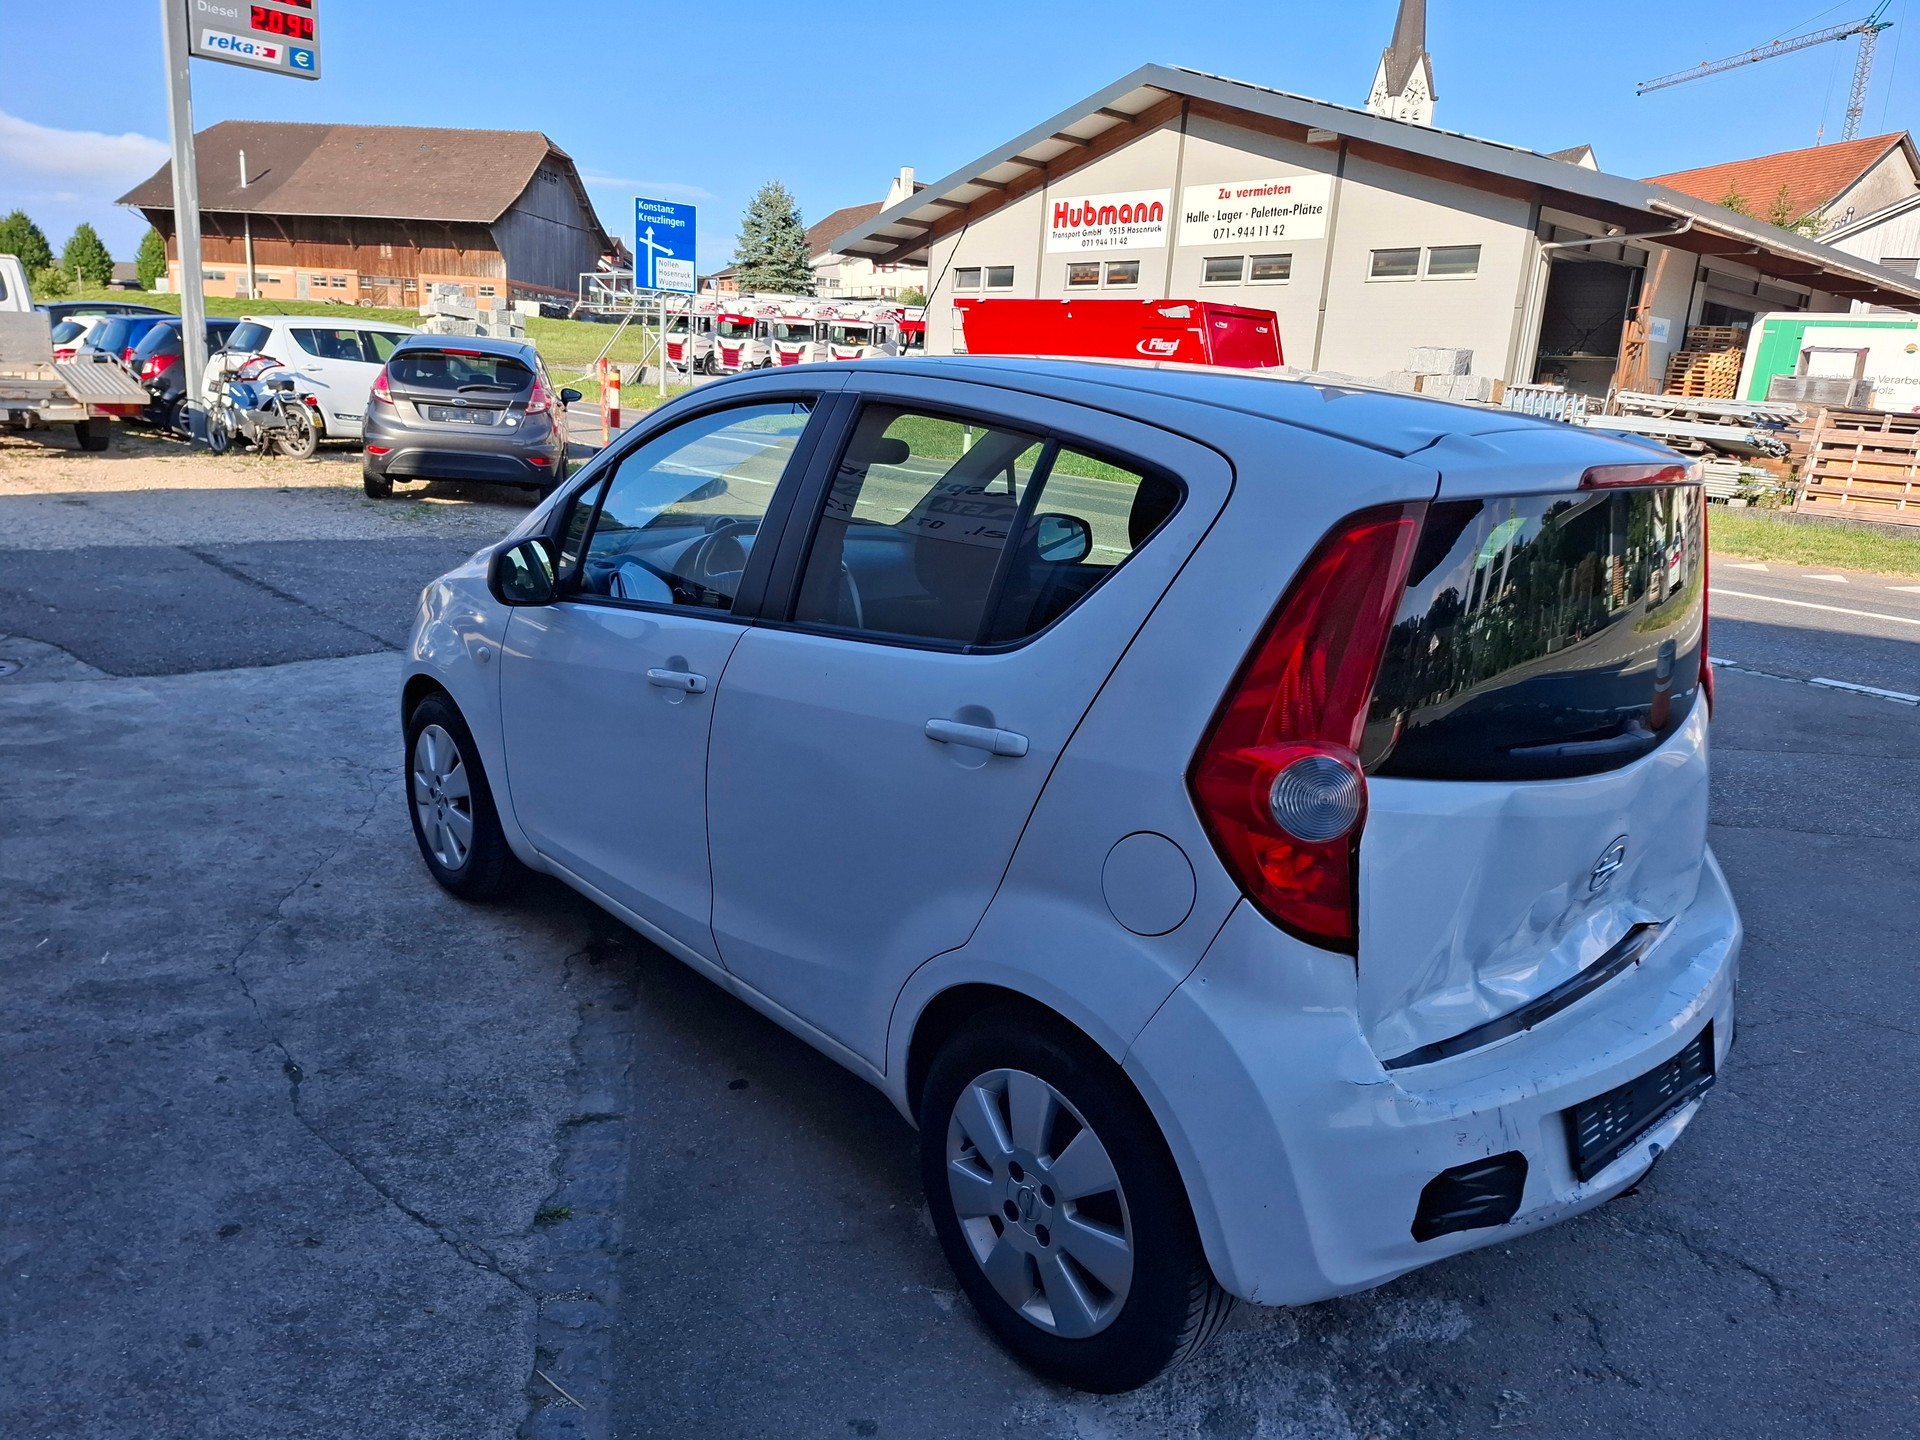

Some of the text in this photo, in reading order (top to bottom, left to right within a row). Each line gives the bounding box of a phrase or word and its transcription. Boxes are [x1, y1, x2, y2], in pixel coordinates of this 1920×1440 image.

[197, 1, 238, 18] Diesel
[1218, 184, 1291, 200] Zu vermieten
[638, 200, 675, 214] Konstanz
[1186, 203, 1323, 223] Halle Lager Paletten-Plätze
[638, 212, 685, 228] Kreuzlingen
[1053, 200, 1163, 228] Hubmann
[1052, 230, 1081, 239] Transport
[1082, 228, 1102, 237] GmbH
[1109, 227, 1126, 235] 9515
[1259, 225, 1269, 237] 11
[1273, 224, 1285, 236] 42
[1081, 237, 1128, 248] 071 944 11 42
[658, 259, 680, 269] Nollen
[658, 269, 691, 279] Hosenruck
[658, 277, 692, 288] Wuppenau
[1148, 337, 1180, 353] Fliegl
[1878, 375, 1920, 386] Verarbe
